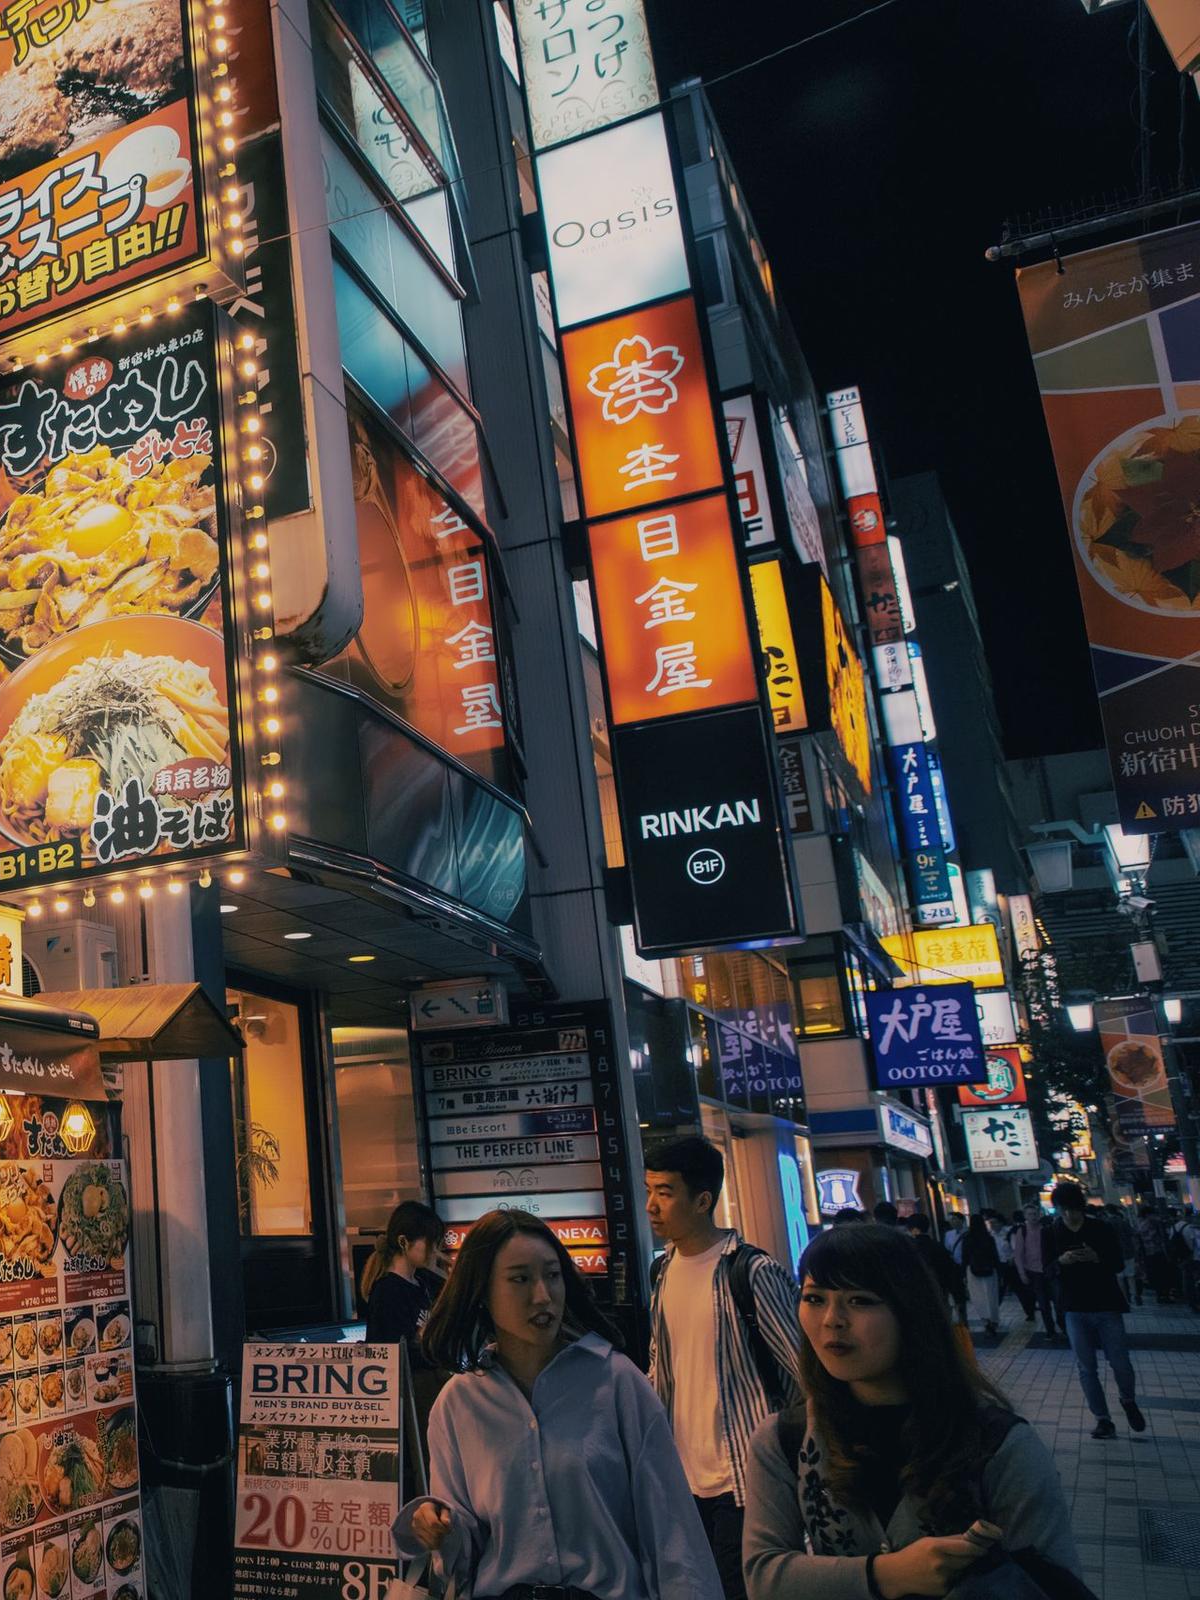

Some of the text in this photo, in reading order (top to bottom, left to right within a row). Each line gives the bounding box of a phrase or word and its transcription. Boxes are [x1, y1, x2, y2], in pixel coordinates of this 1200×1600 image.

[552, 198, 674, 249] Oasis
[1063, 262, 1195, 309] みんなが集ま
[1123, 724, 1186, 746] CHUOH
[154, 766, 231, 793] 東京名物
[90, 775, 235, 864] 油そば
[640, 798, 762, 840] RINKAN
[692, 858, 720, 875] B1F
[916, 854, 937, 870] 9F
[879, 992, 973, 1056] 大戸屋
[432, 1065, 492, 1082] BRING
[887, 1064, 972, 1082] OOTOYA
[471, 1123, 507, 1133] Escort
[455, 1139, 574, 1160] THE PERFECT LINE
[251, 1363, 389, 1396] BRING
[254, 1399, 288, 1409] MEN'S
[290, 1400, 329, 1410] BRAND
[239, 1491, 307, 1549] 20
[310, 1497, 391, 1527] 査定額
